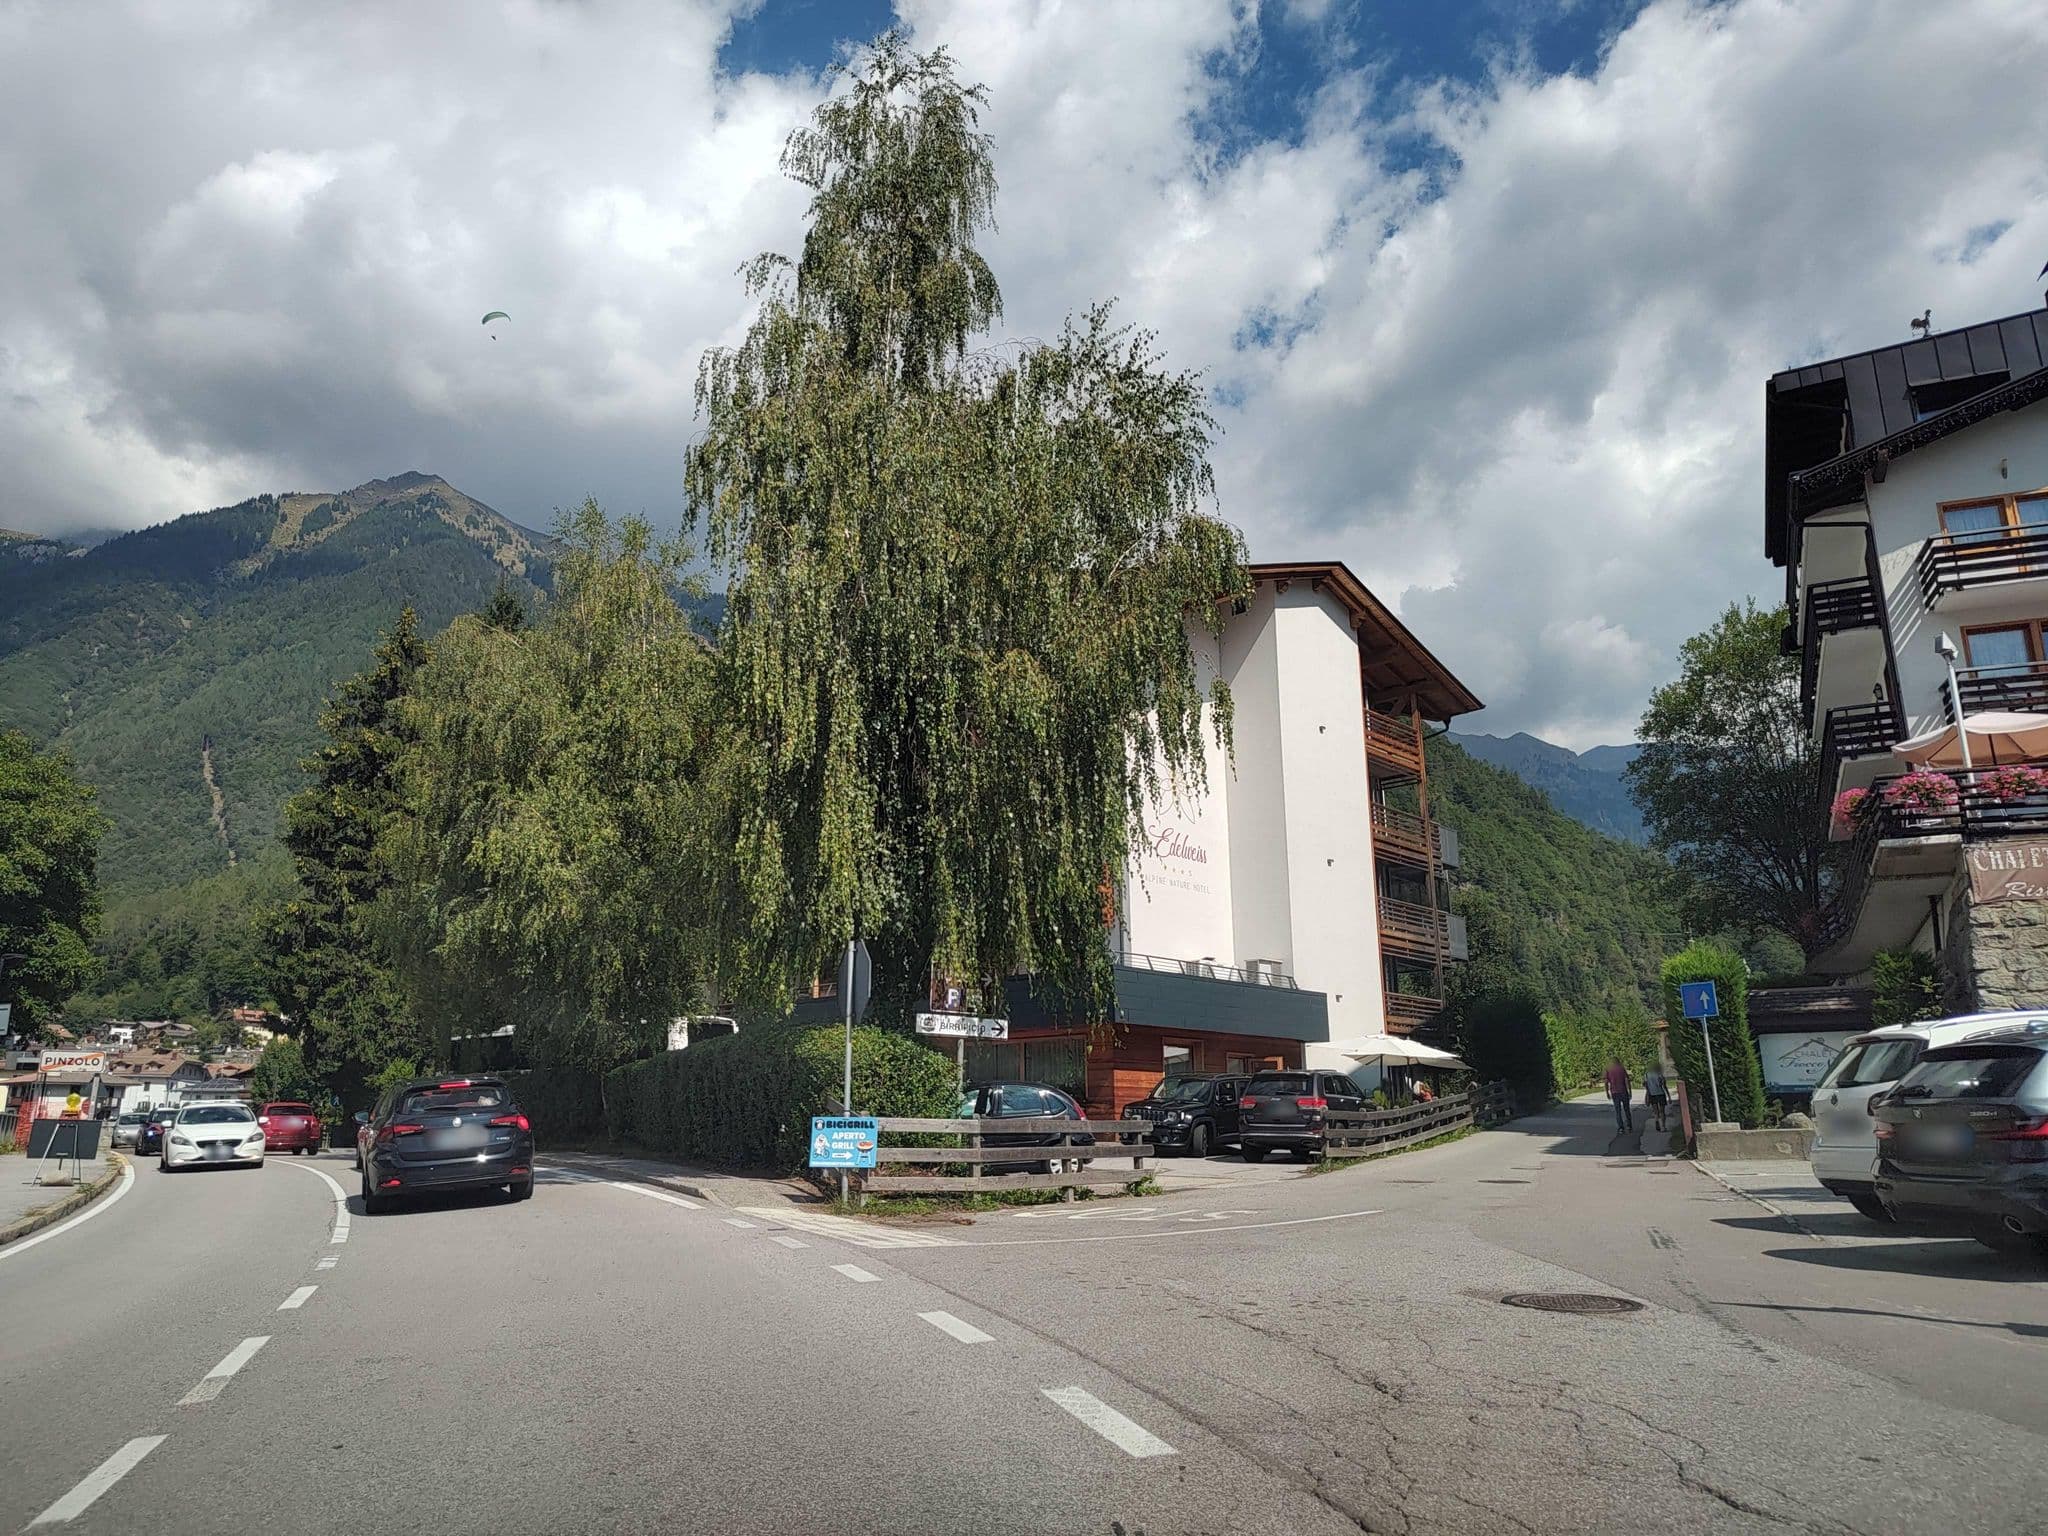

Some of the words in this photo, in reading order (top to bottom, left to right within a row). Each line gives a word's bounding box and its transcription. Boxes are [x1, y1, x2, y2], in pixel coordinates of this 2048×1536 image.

[1148, 825, 1207, 864] Edelweiss
[2005, 881, 2048, 898] Ris
[45, 1056, 101, 1067] PINZOLO
[826, 1120, 875, 1129] BICIGRILL
[831, 1131, 867, 1140] APERTO
[831, 1141, 855, 1150] GRILL
